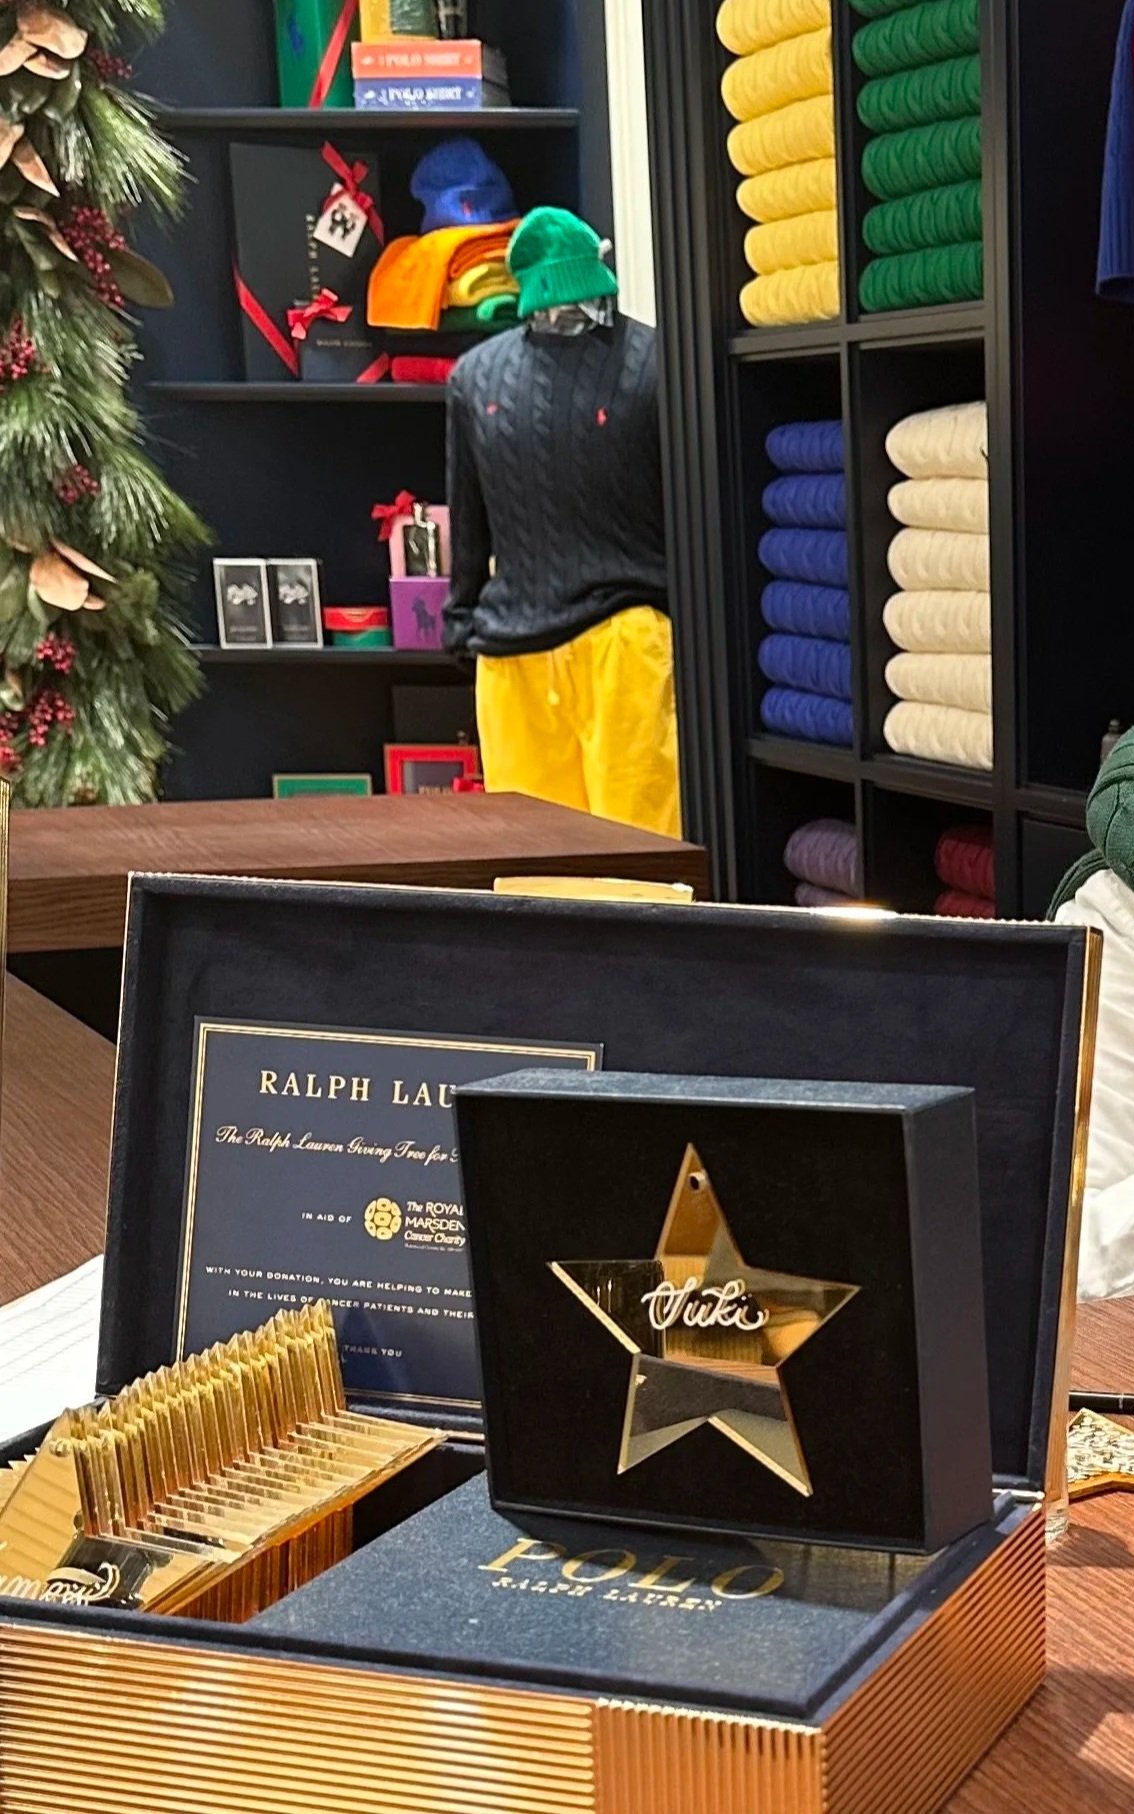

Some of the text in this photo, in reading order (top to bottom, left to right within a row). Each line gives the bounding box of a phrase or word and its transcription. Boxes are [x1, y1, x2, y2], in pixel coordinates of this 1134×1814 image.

[259, 1070, 370, 1102] RALPH
[215, 1125, 243, 1144] The
[244, 1127, 291, 1153] Ralph
[292, 1131, 344, 1153] Lauren
[347, 1136, 392, 1163] Giving
[394, 1140, 426, 1159] Tree
[423, 1144, 448, 1166] for
[317, 1213, 334, 1221] AID
[338, 1214, 352, 1223] OF
[406, 1201, 423, 1212] The
[404, 1230, 466, 1247] Cancer Charity
[205, 1266, 473, 1298] WITH YOUR DONATION, YOU ARE HELPING TO MAKE
[228, 1289, 240, 1297] IN
[243, 1290, 264, 1299] THE
[267, 1293, 297, 1303] LIVES
[300, 1295, 315, 1304] OF
[363, 1301, 414, 1314] PATIENTS
[417, 1307, 439, 1316] AND
[443, 1309, 474, 1319] THEIR
[380, 1348, 402, 1357] YOU
[477, 1537, 784, 1600] POLO
[491, 1576, 722, 1612] RALPH LAUREN
